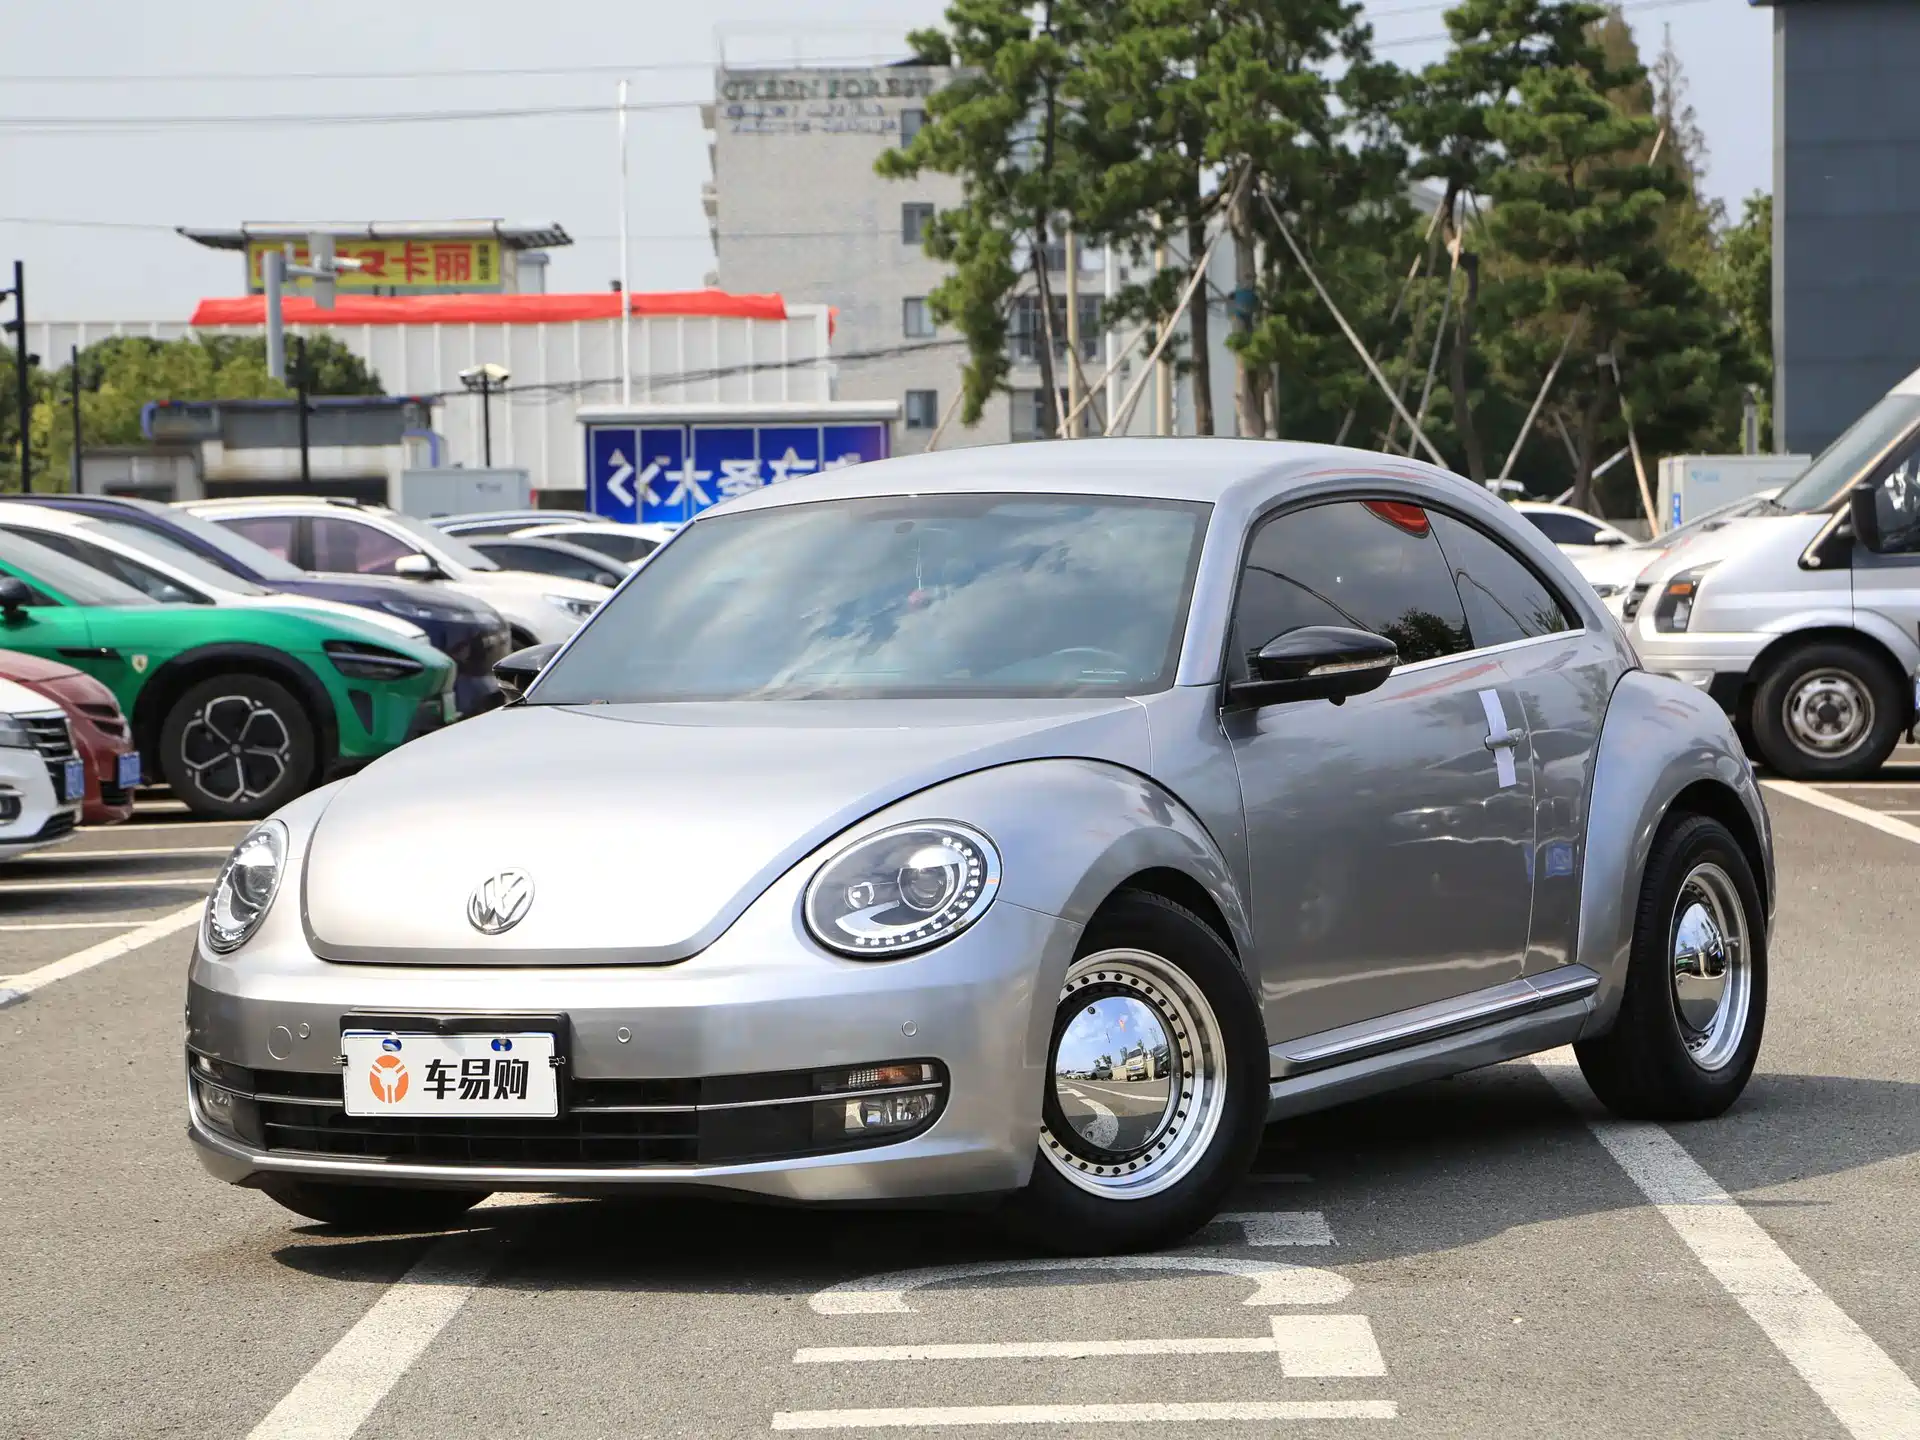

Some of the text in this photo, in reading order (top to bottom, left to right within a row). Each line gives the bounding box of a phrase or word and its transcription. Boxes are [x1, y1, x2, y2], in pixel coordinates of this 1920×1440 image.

[722, 78, 820, 101] GREEN
[423, 1058, 529, 1100] 车易购
